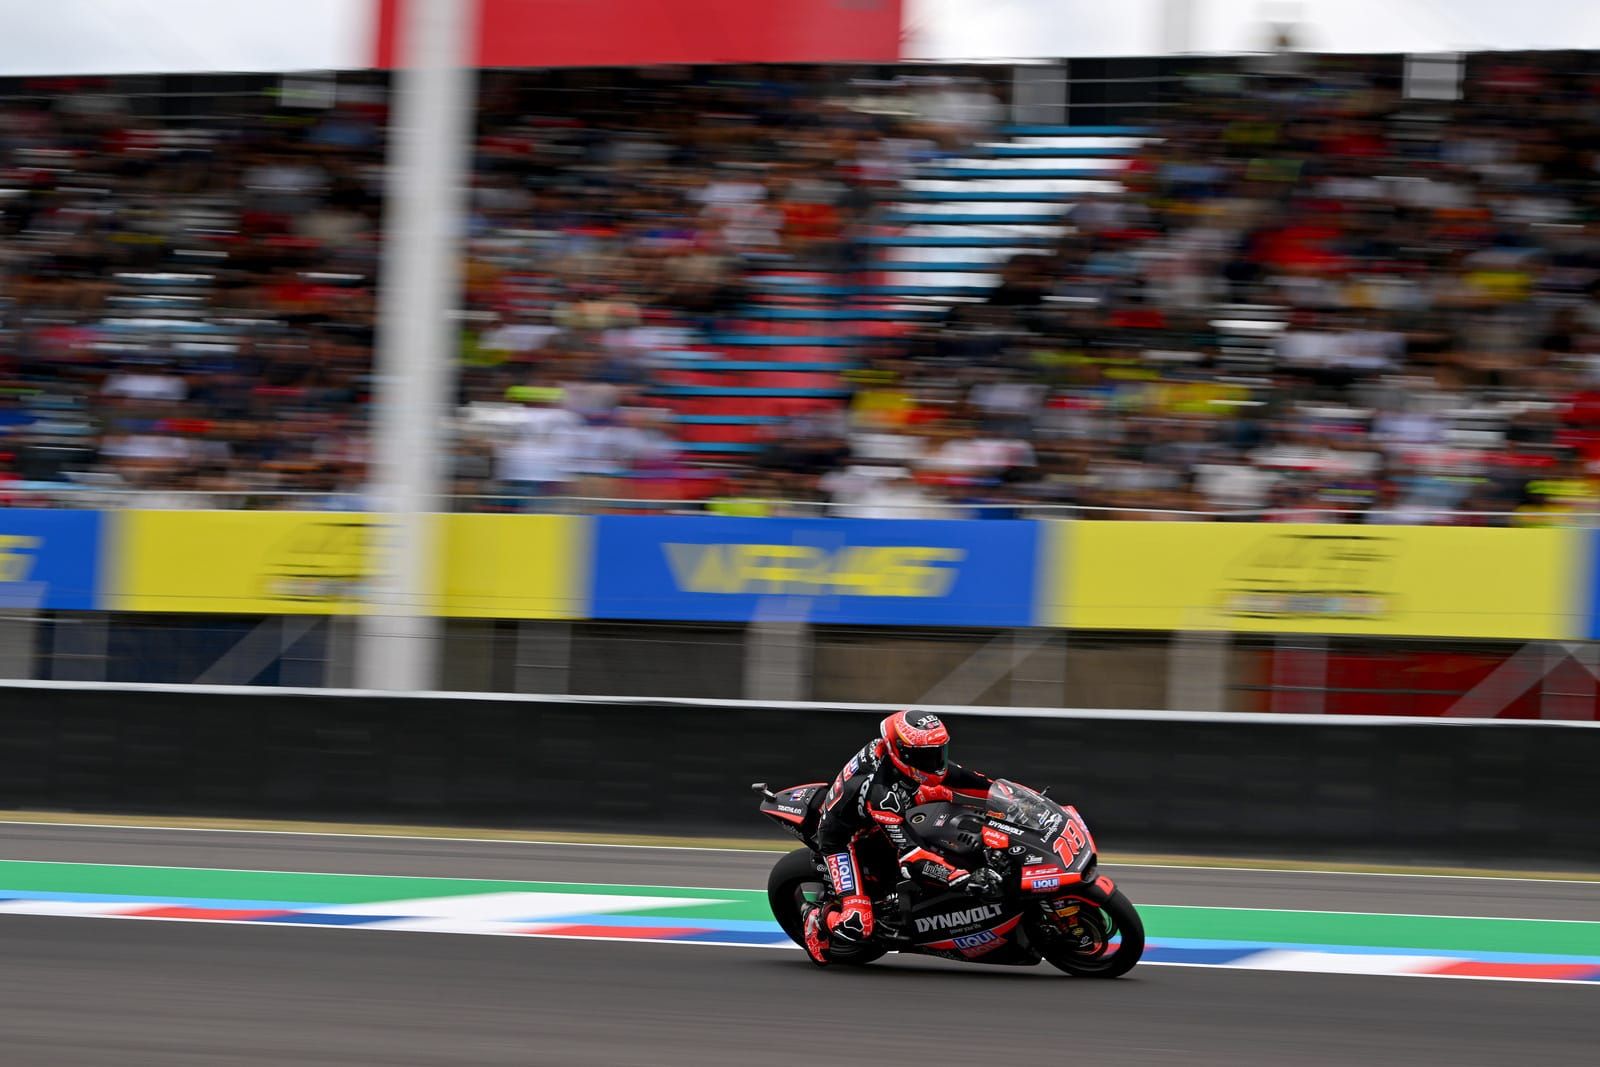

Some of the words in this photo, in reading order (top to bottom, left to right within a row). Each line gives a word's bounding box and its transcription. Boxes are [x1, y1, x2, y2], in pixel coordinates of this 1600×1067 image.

[988, 820, 1025, 836] DYNAVOLT
[1053, 819, 1086, 869] 18
[828, 856, 843, 894] MOLY
[837, 855, 852, 889] LIQUI
[1033, 879, 1058, 889] LIQUI
[914, 903, 1003, 933] DYNAVOLT
[954, 930, 997, 949] LIQUI
